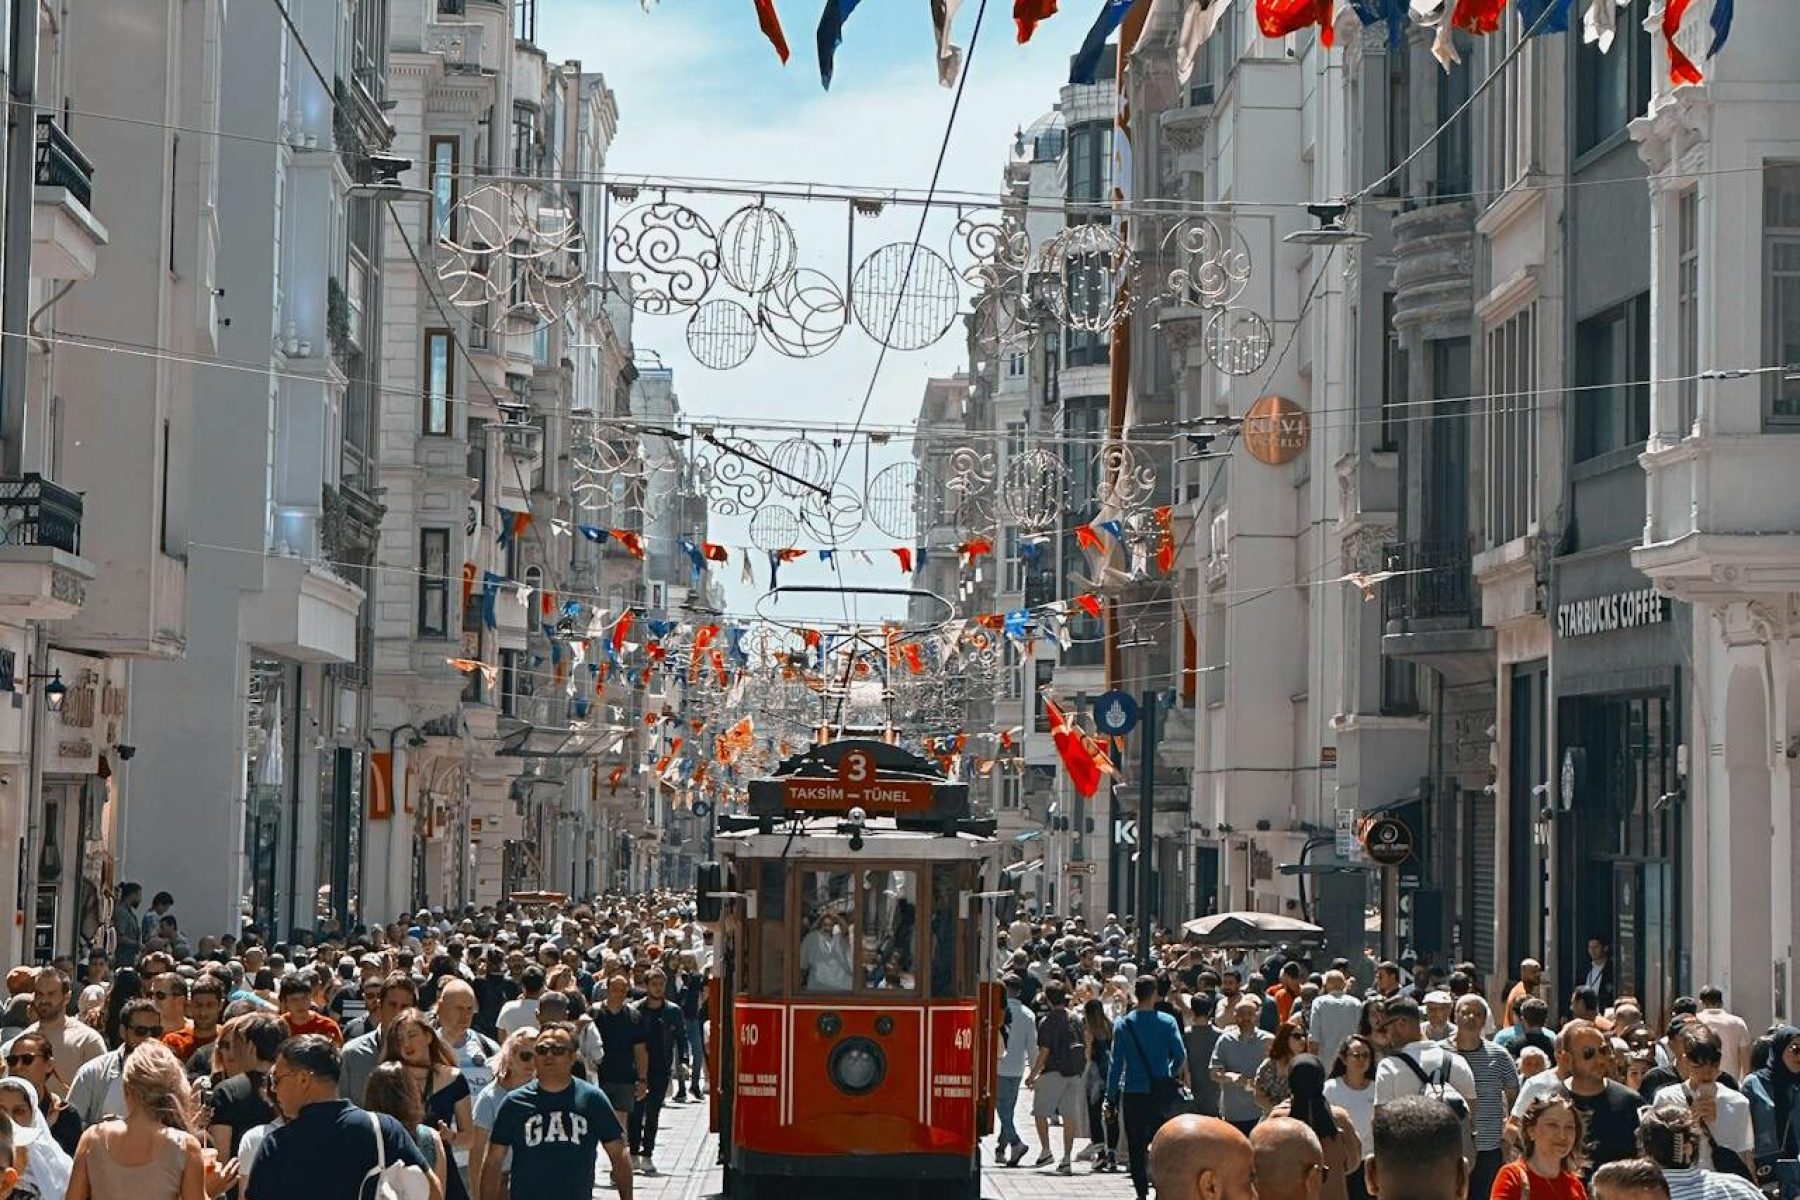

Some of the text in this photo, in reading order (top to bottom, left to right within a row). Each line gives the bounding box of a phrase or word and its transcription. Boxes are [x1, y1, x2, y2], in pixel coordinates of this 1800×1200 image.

[1557, 588, 1662, 637] STARBUCKS COFFEE
[847, 754, 867, 782] 3
[789, 785, 844, 800] TAKSİM
[863, 786, 910, 803] TÜNEL
[954, 1027, 972, 1050] 410
[525, 1110, 588, 1147] GAP
